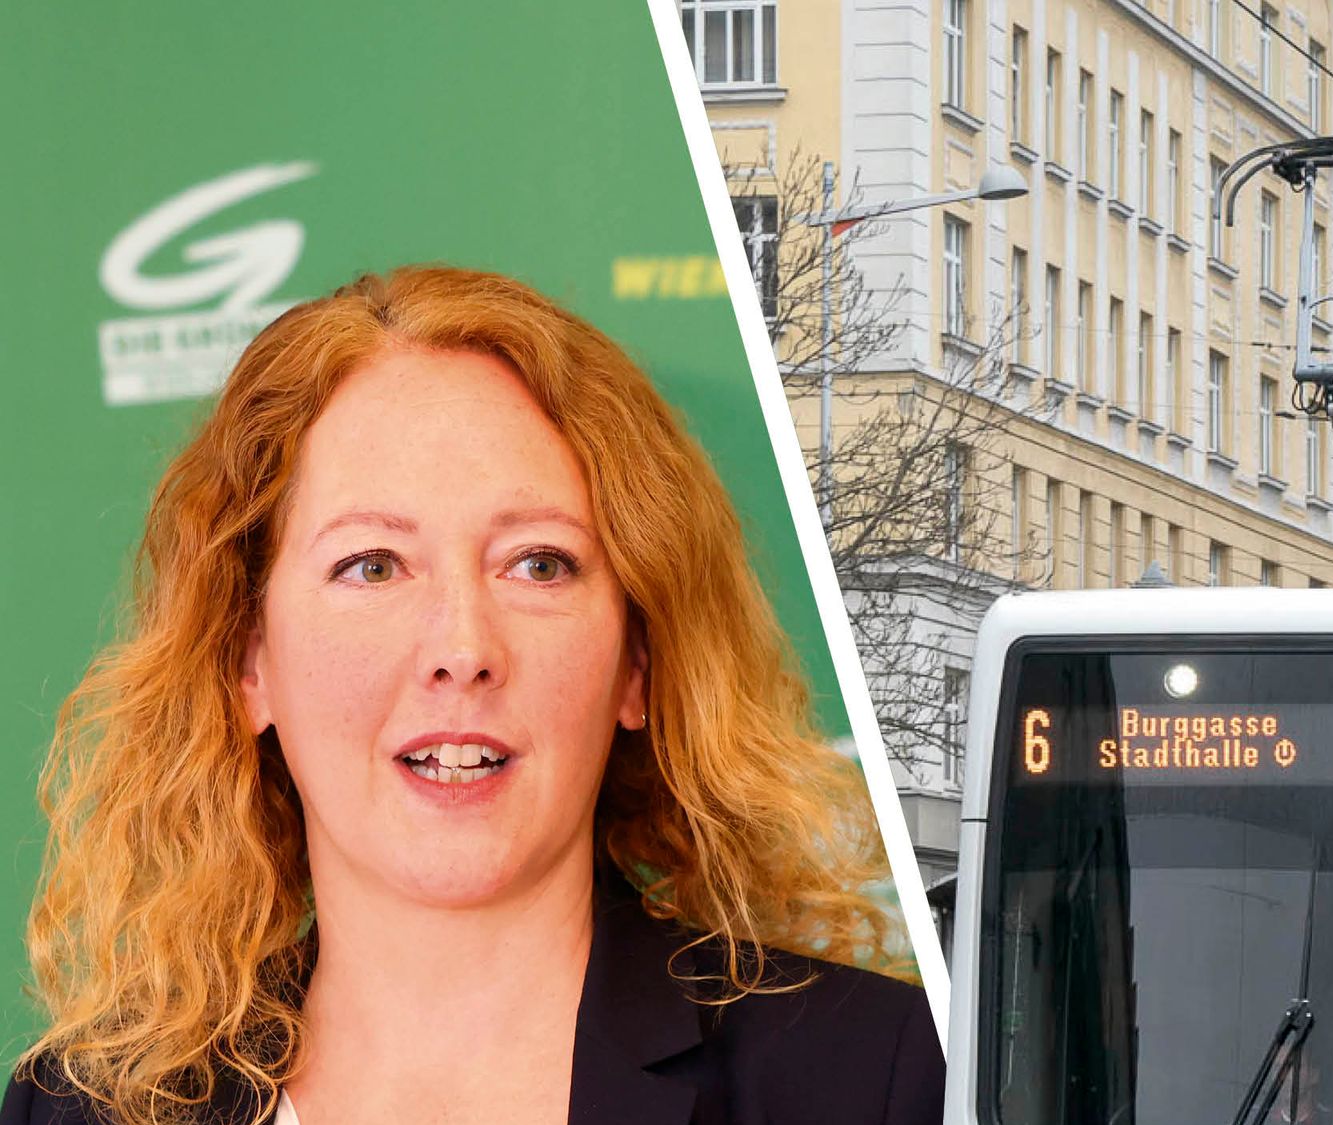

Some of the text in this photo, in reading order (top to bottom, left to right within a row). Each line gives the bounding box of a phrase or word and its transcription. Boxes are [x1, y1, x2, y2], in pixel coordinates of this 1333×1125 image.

[1023, 708, 1278, 773] 6 Burggasse
[1099, 738, 1259, 768] Stadthalle
